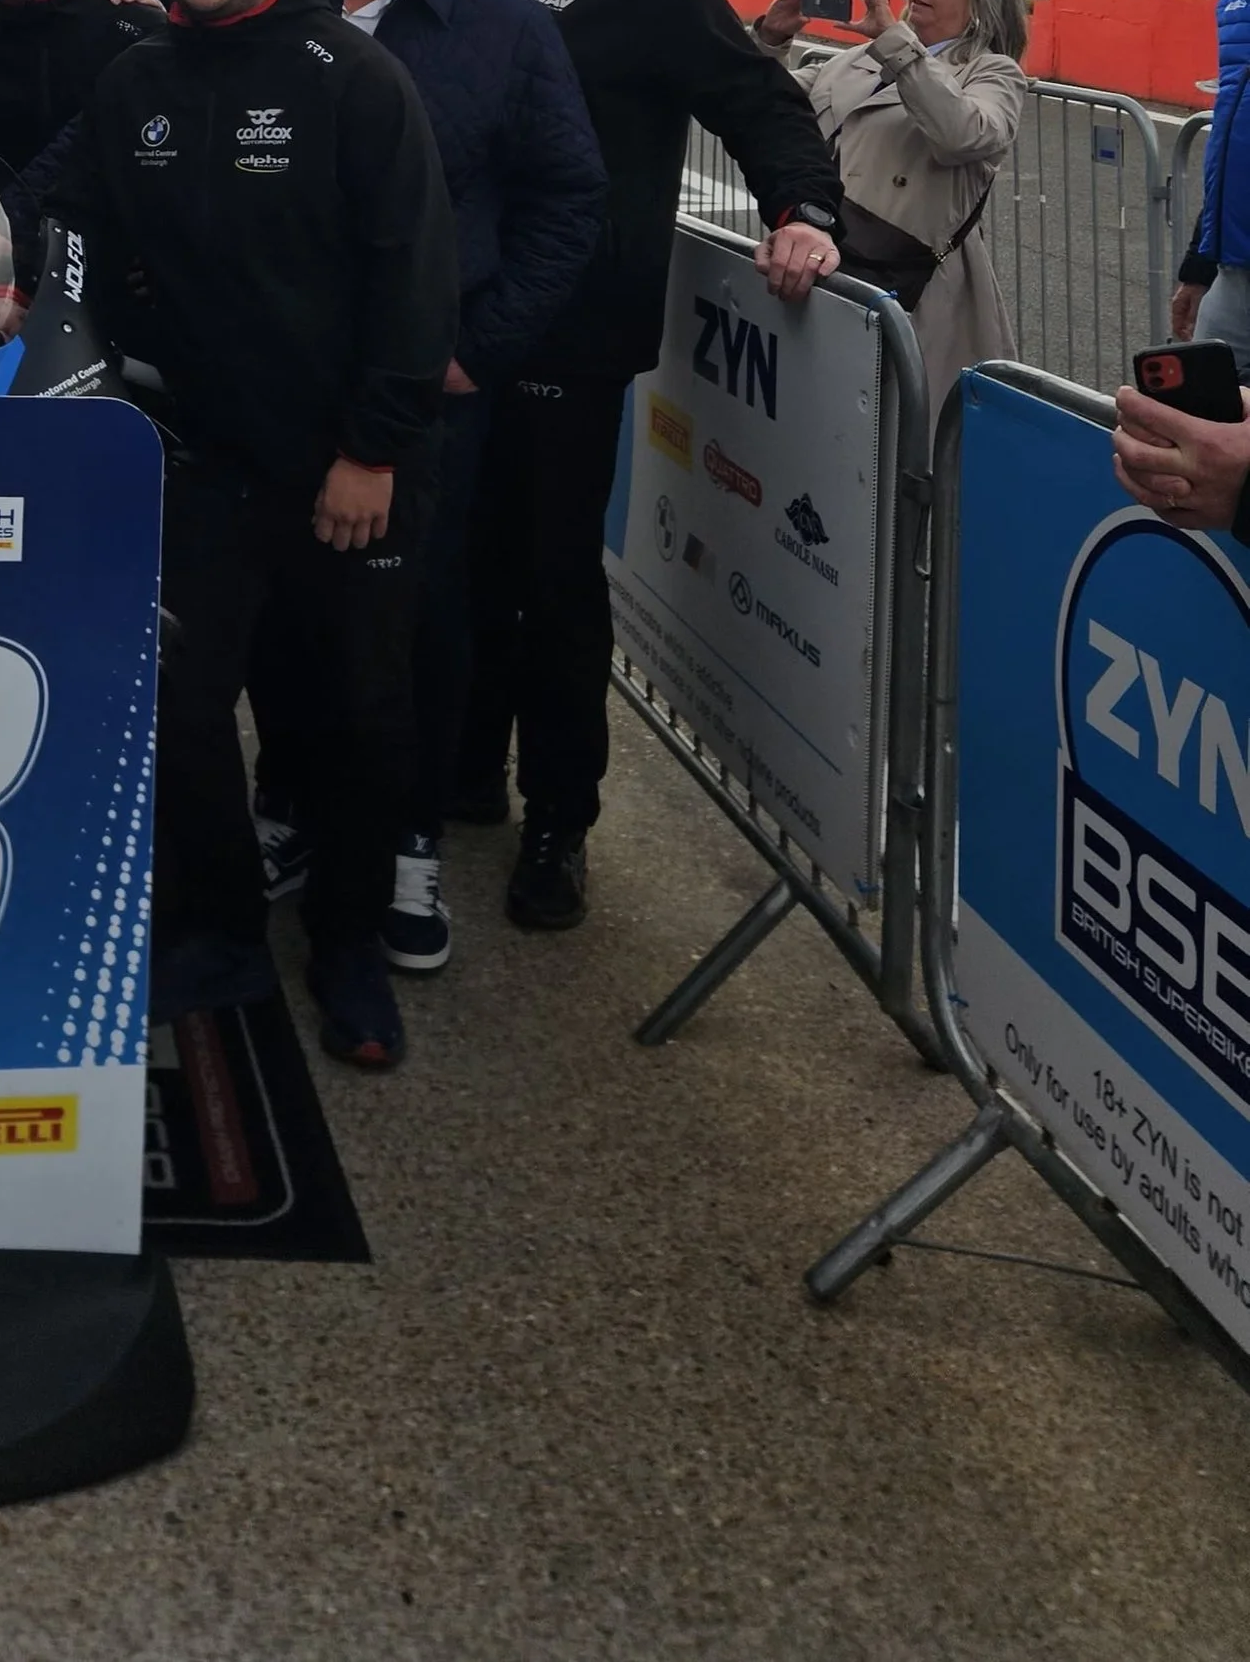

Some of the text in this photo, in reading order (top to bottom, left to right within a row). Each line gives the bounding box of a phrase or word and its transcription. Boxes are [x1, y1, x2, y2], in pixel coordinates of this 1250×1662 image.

[238, 154, 290, 168] alpha
[36, 358, 107, 397] otorrad Central
[693, 294, 778, 421] ZYN
[774, 527, 839, 587] CAROLE NASH
[756, 600, 821, 668] MAXUS
[1085, 618, 1250, 838] ZYN
[1071, 900, 1140, 978] BRITISH
[1005, 1022, 1250, 1309] Only for use by adults who
[1092, 1069, 1244, 1247] 18+ ZYN is not
